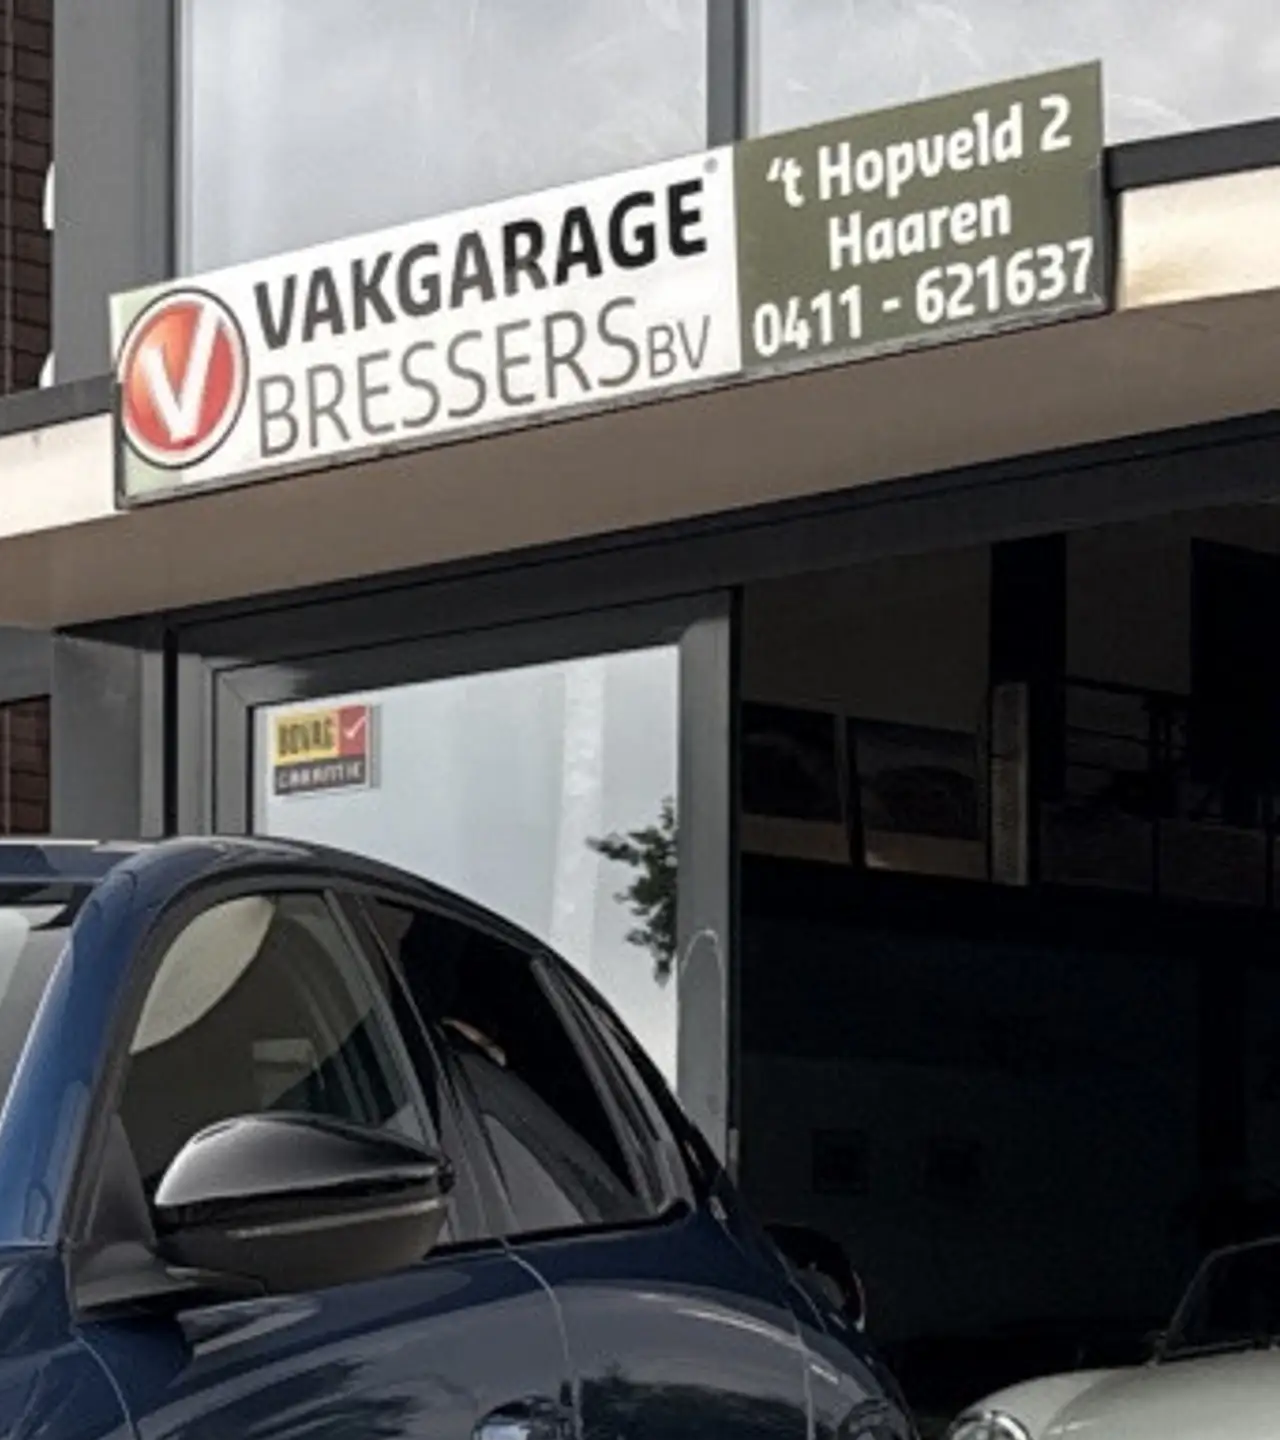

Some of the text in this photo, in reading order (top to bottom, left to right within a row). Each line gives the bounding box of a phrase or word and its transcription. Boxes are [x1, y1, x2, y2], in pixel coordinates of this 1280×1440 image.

[817, 102, 1024, 200] Hopveld
[1040, 93, 1073, 152] 2
[253, 176, 709, 351] VAKGARAGE
[828, 193, 1012, 271] Haaren
[752, 285, 863, 358] 0411
[915, 236, 1095, 325] 621637
